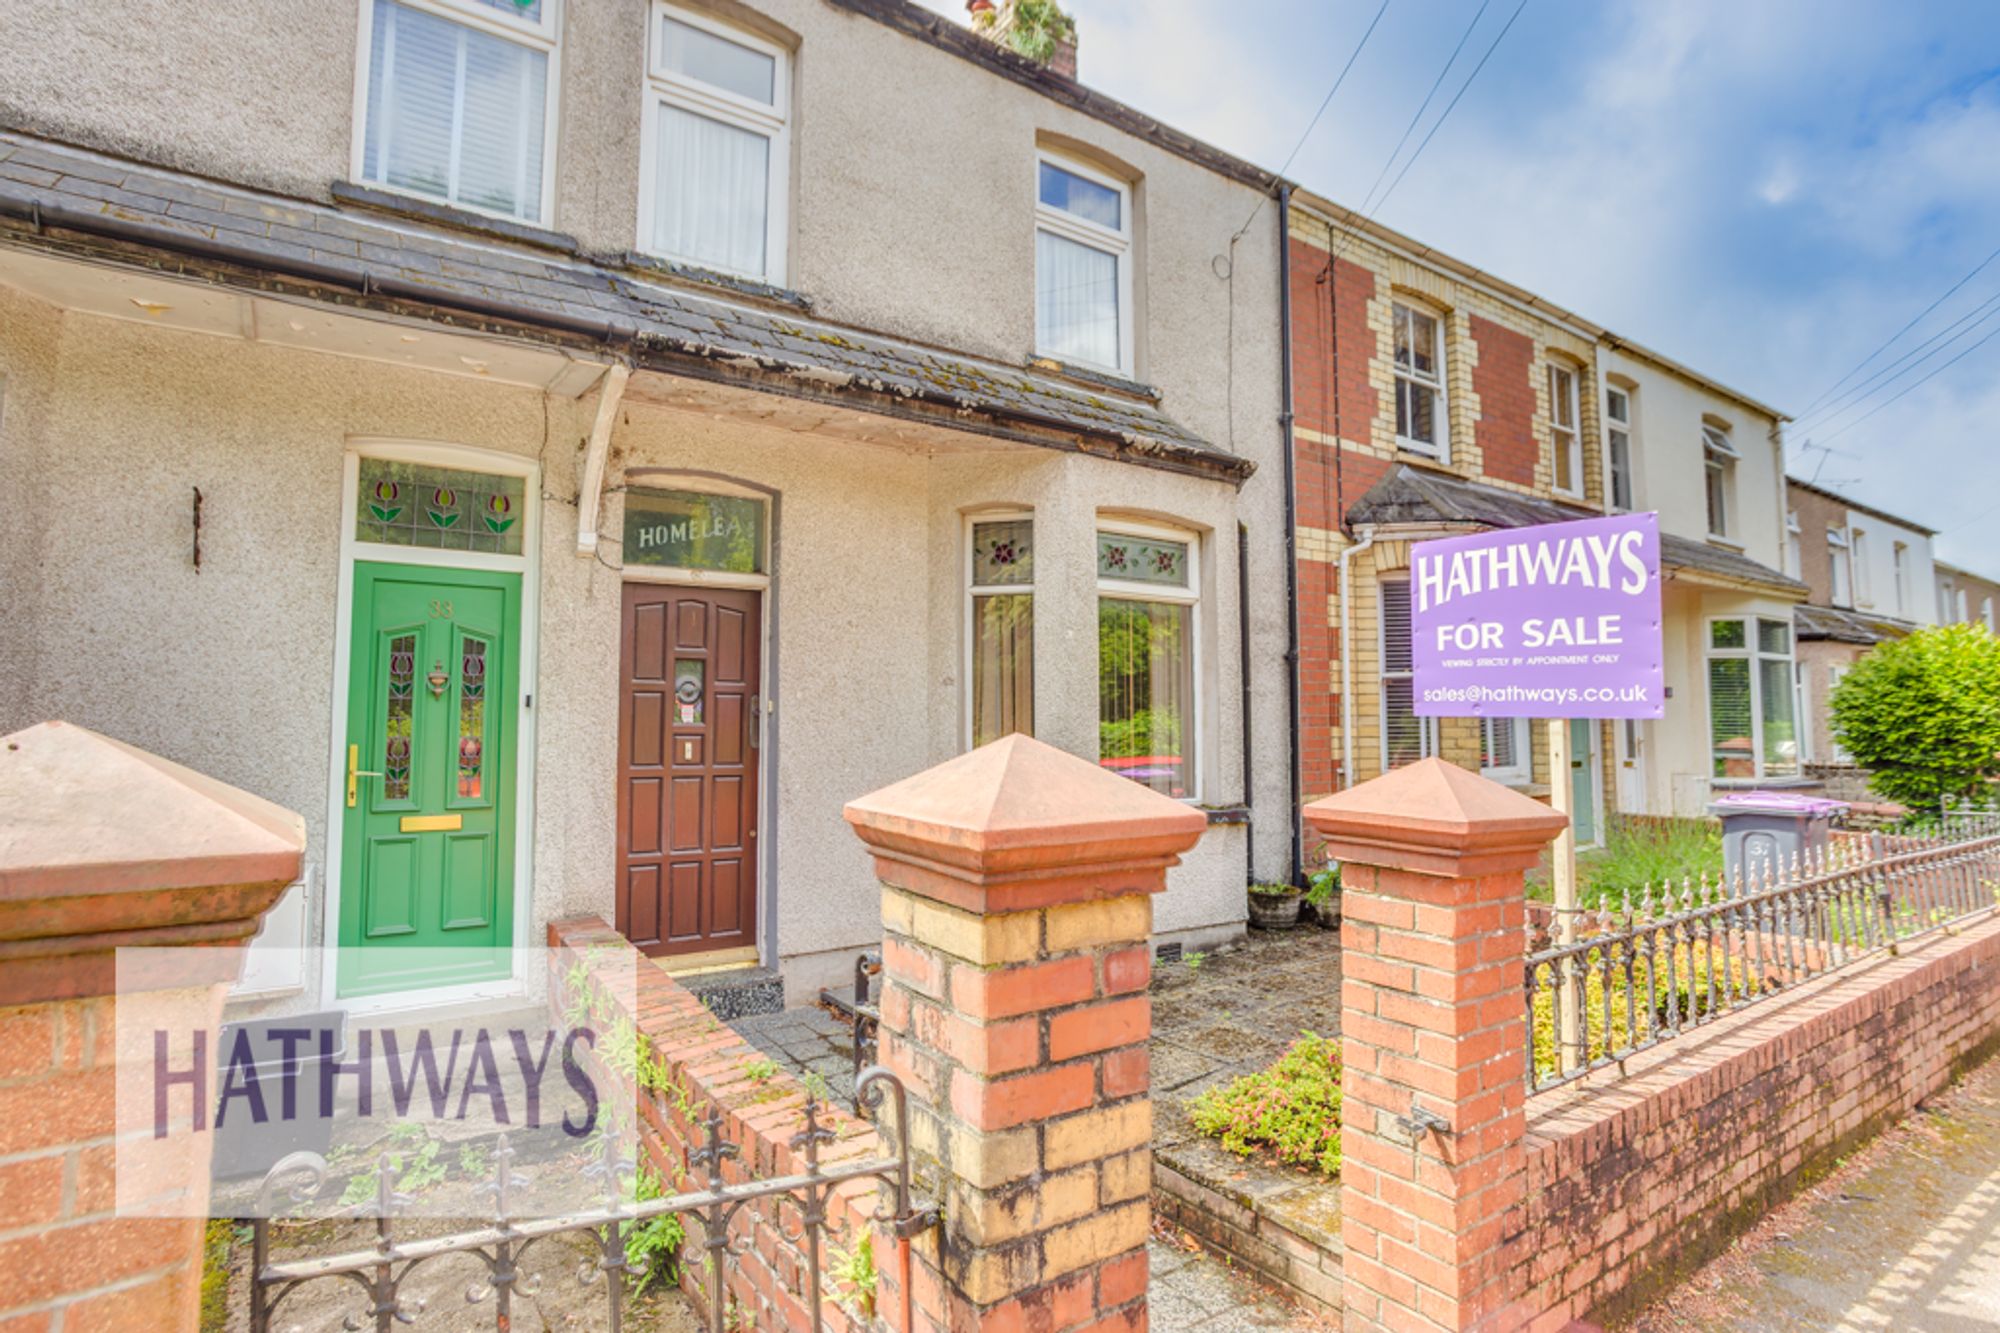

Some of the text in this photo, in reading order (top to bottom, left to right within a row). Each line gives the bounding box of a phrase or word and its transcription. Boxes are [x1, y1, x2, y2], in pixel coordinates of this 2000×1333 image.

[1418, 531, 1648, 613] HATHWAYS
[428, 600, 454, 619] 33
[1437, 615, 1623, 651] FOR SALE
[1441, 654, 1620, 668] VIEWING STRICTLY BY APPOINTMENT ONLY
[1423, 684, 1649, 704] sales@hathways.co.uk
